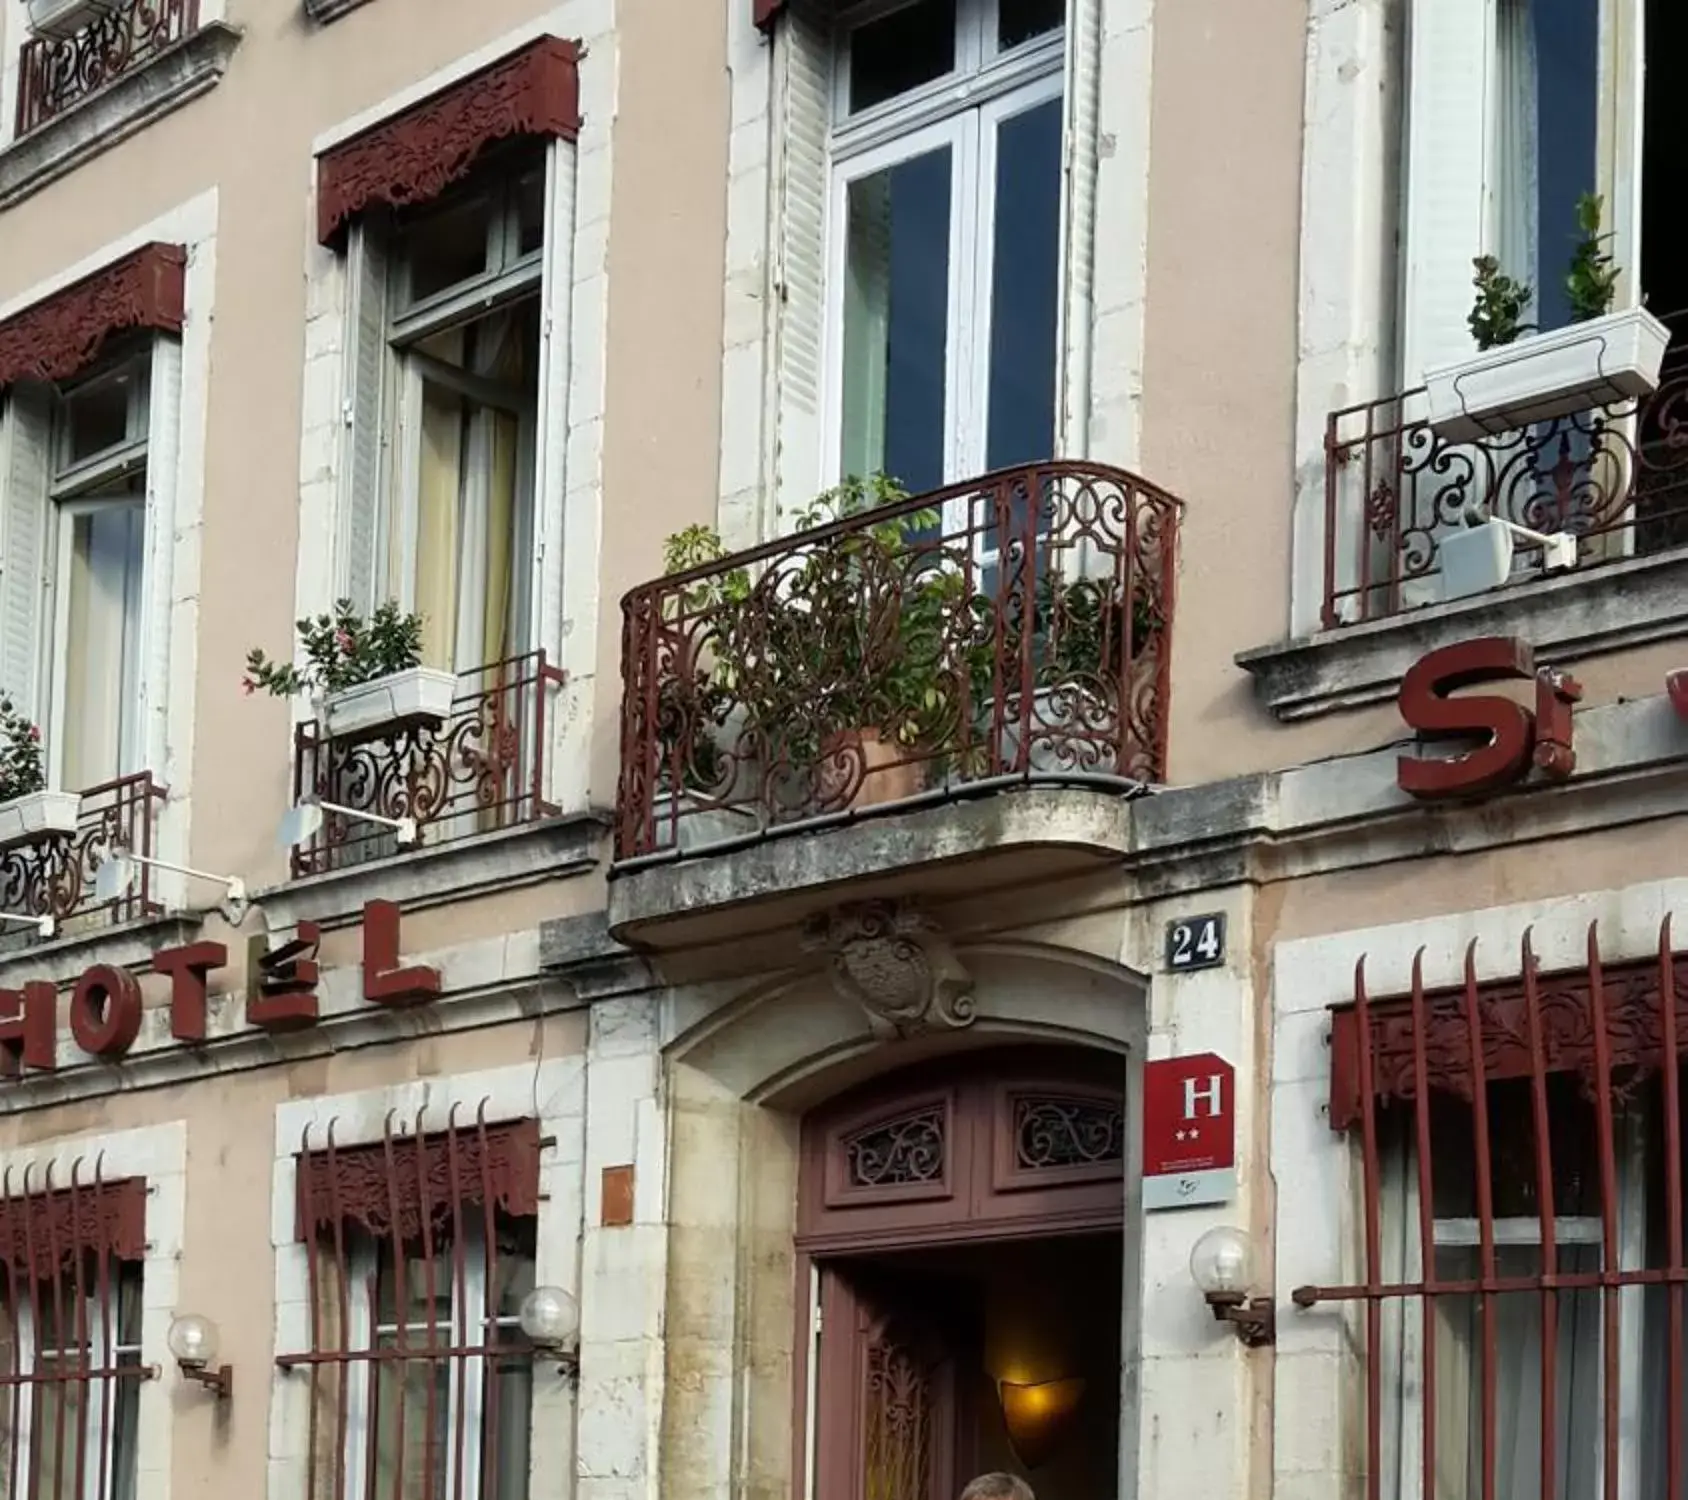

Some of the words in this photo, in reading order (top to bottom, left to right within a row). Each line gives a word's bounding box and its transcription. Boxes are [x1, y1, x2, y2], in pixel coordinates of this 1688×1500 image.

[1173, 920, 1218, 965] 24
[0, 899, 442, 1079] HOTEL
[1182, 1073, 1224, 1120] H
